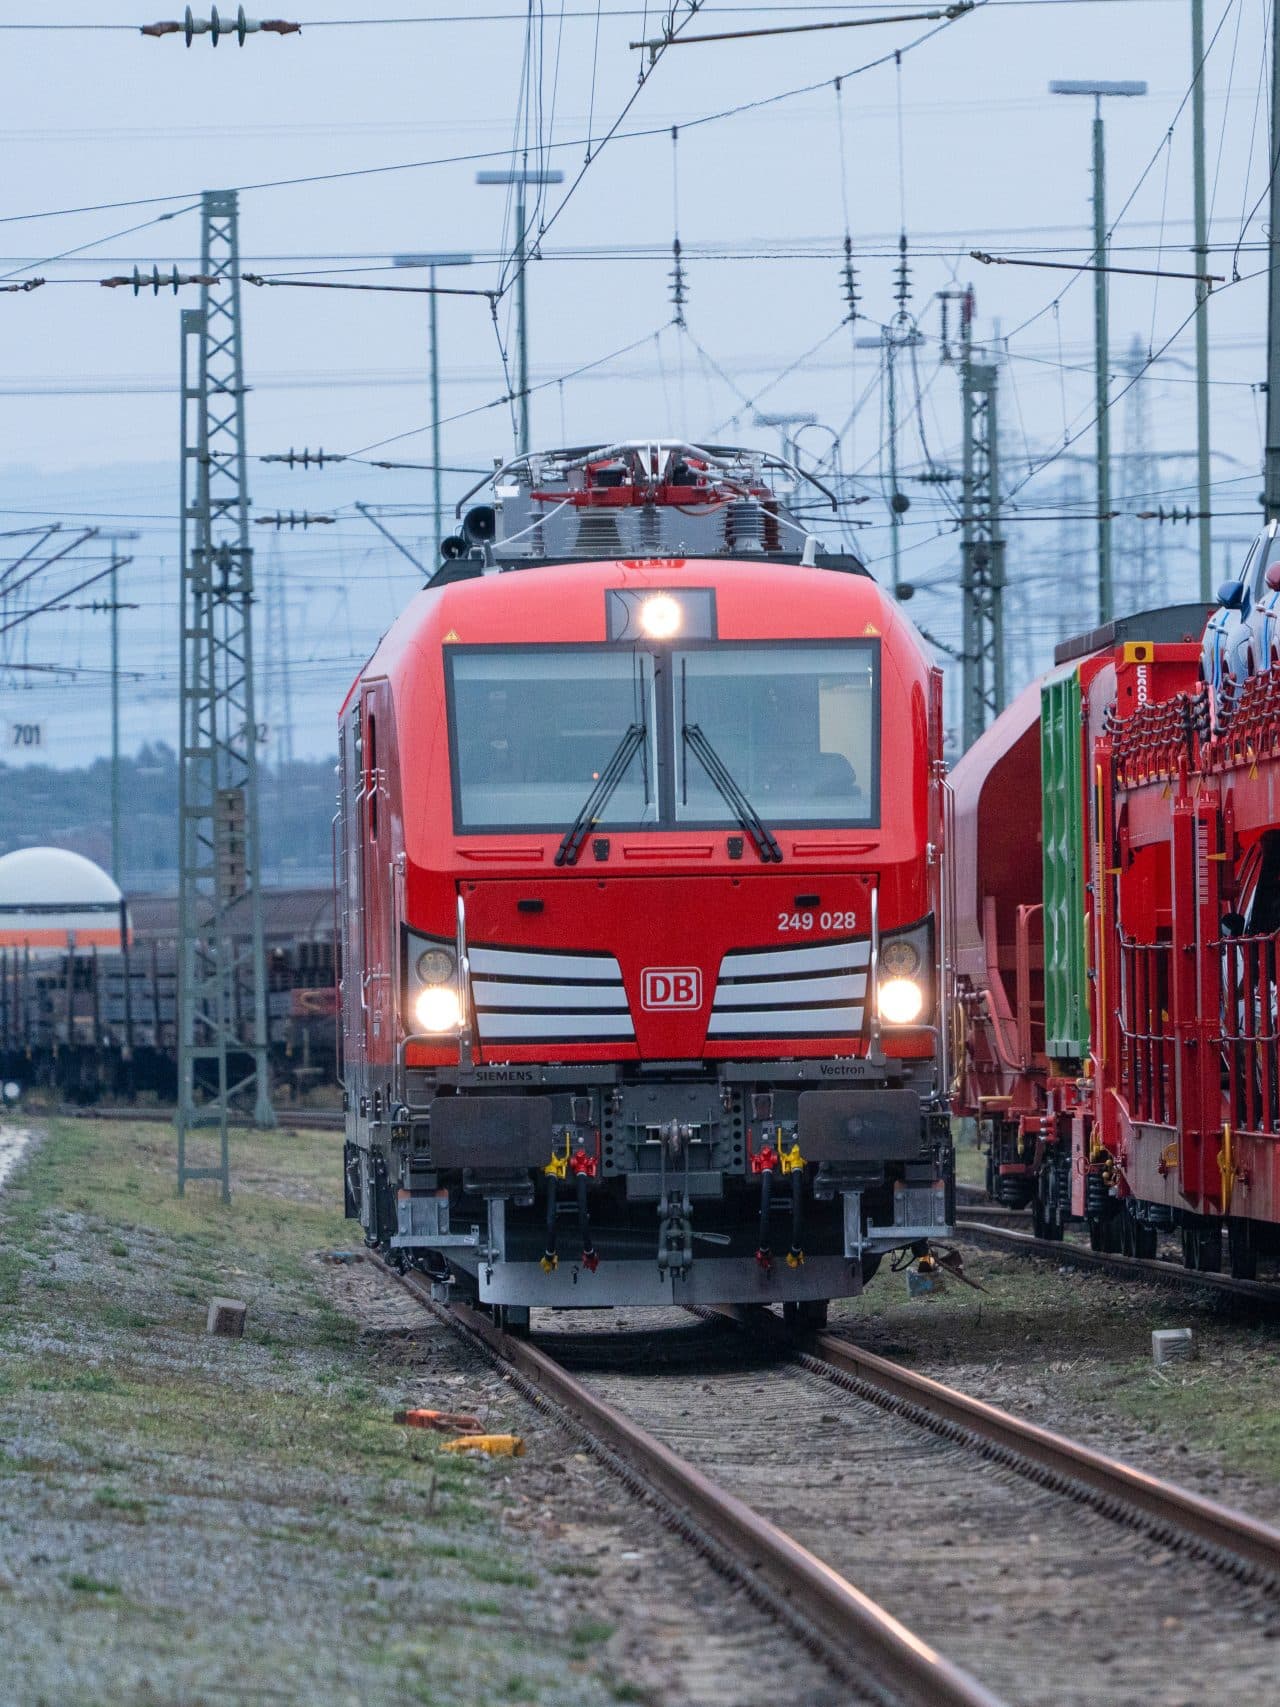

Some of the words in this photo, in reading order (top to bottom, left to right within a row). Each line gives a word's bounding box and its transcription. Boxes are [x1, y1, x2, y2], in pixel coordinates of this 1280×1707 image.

[13, 724, 40, 745] 701
[778, 912, 813, 930] 249
[820, 912, 856, 929] 028
[647, 973, 697, 1006] DB
[477, 1071, 533, 1081] SIEMENS
[821, 1065, 865, 1075] Vectron
